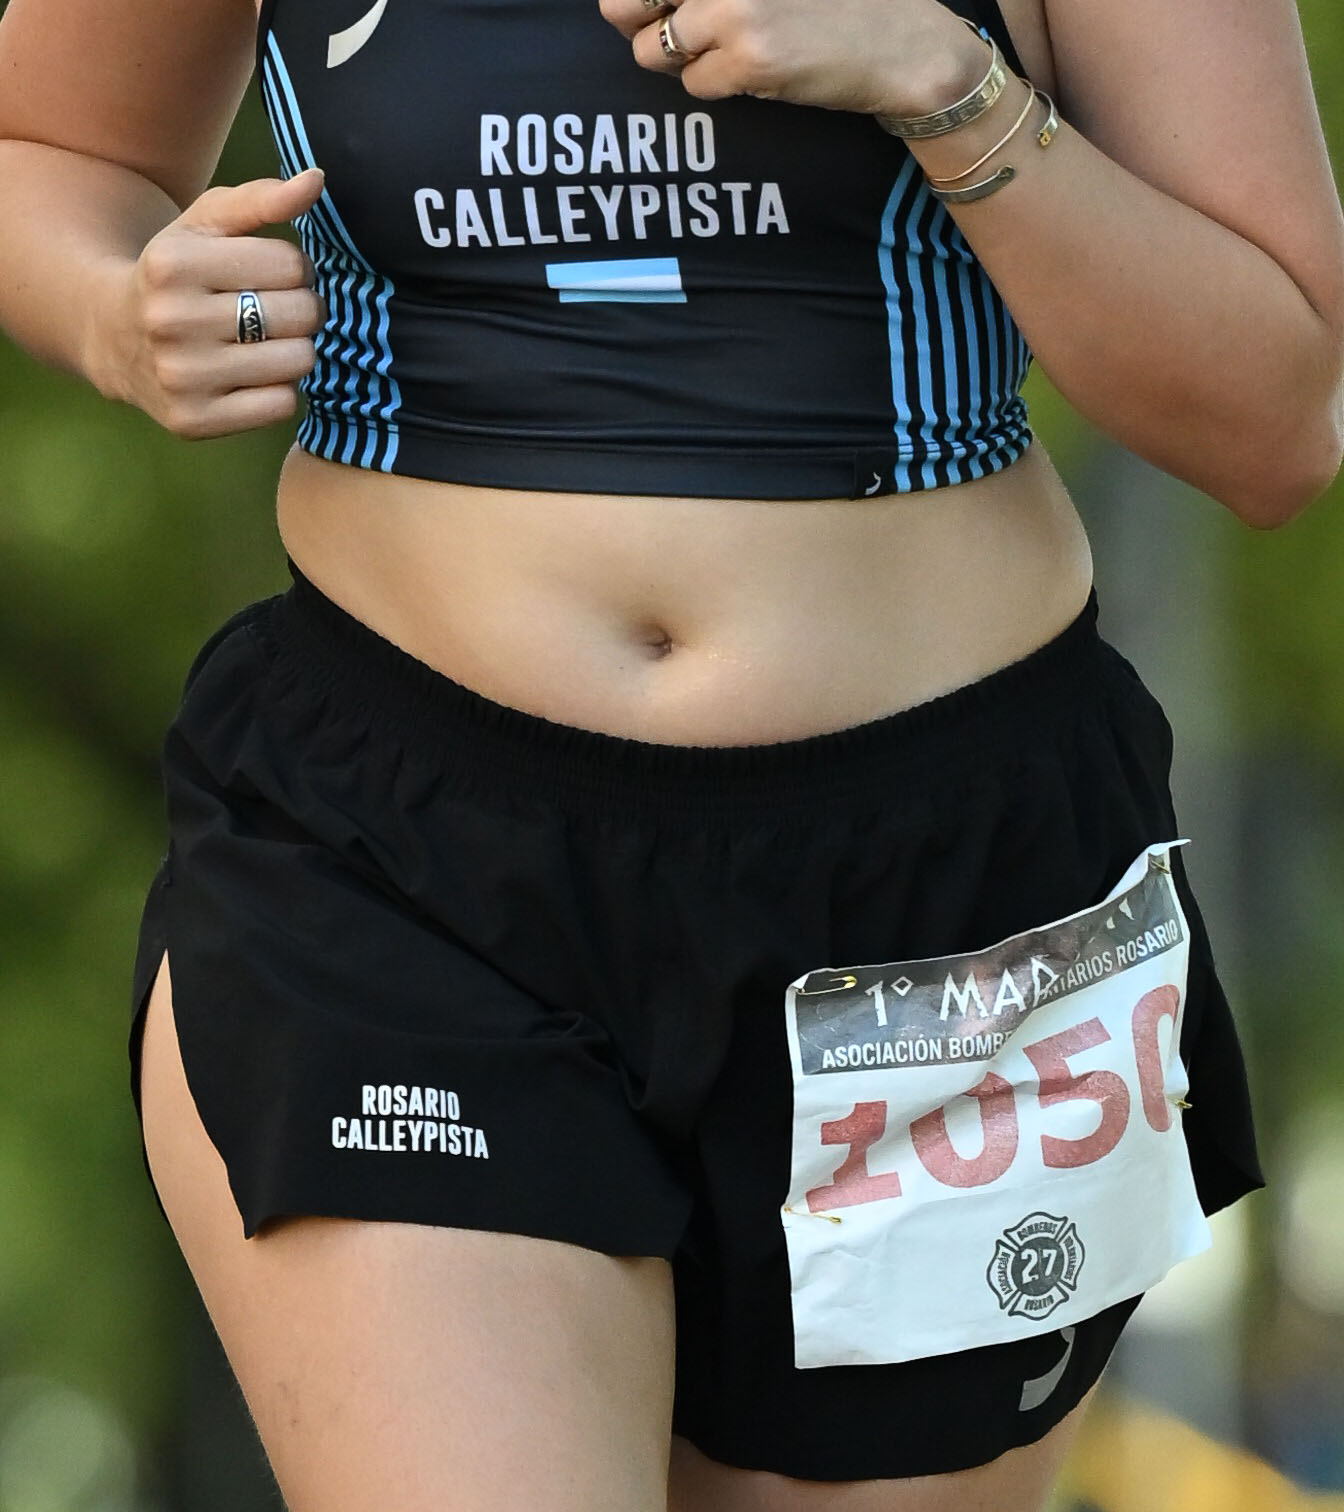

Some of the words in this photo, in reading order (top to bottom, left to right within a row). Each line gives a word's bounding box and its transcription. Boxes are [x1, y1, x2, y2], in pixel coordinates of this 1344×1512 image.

[480, 111, 716, 176] ROSARIO
[413, 182, 790, 248] CALLEYPISTA
[822, 1033, 943, 1069] ASOCIACIÓN
[1116, 919, 1179, 967] ROSARIO
[362, 1085, 461, 1121] ROSARIO
[805, 984, 1180, 1214] 1050
[331, 1116, 490, 1159] CALLEYPISTA
[1020, 1248, 1058, 1285] 27
